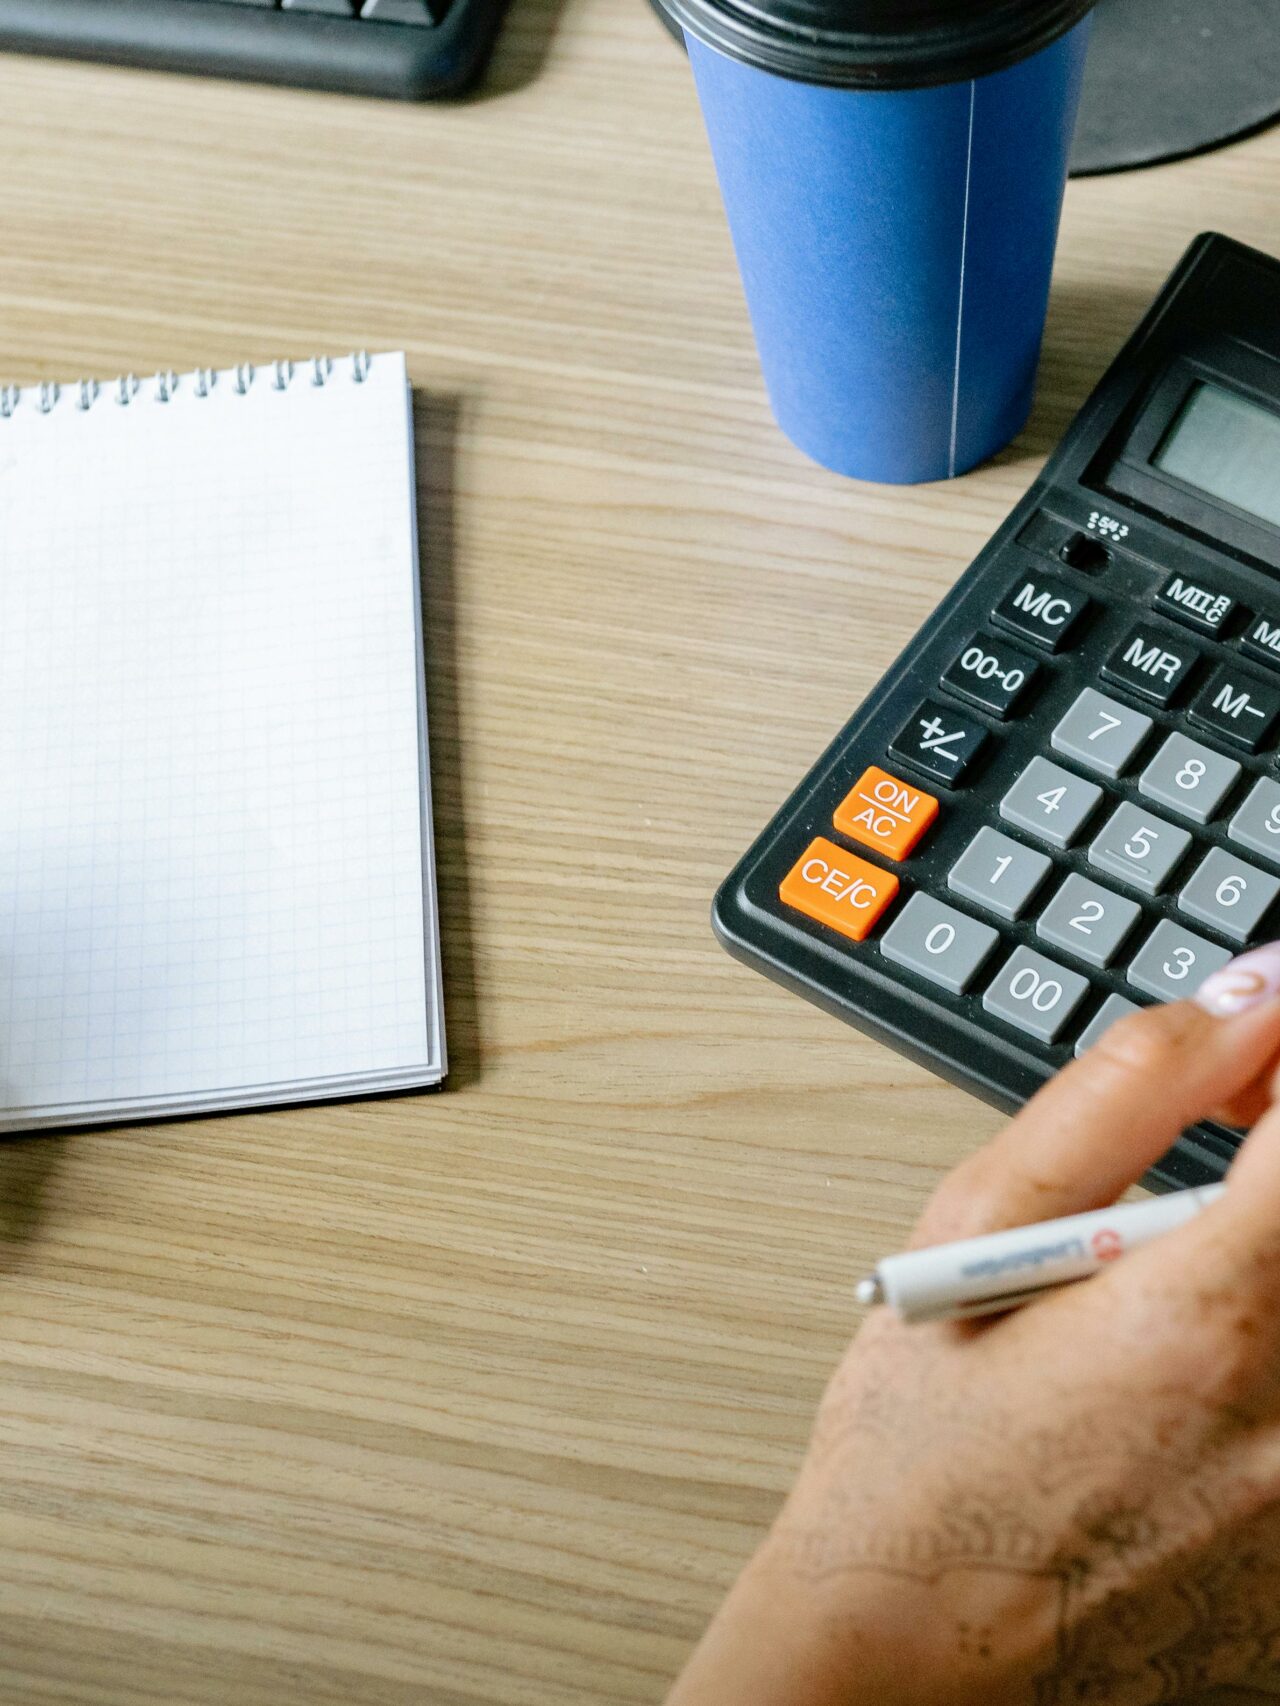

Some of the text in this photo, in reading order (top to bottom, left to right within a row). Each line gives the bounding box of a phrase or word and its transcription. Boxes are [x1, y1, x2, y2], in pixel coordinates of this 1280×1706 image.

[1013, 584, 1071, 625] MC
[1123, 638, 1181, 684] MR
[1088, 712, 1122, 741] 7
[1175, 759, 1207, 790] 8
[874, 780, 920, 814] ON
[1036, 786, 1068, 815] 4
[852, 807, 897, 837] AC
[1124, 826, 1158, 859] 5
[801, 858, 877, 909] CE/C
[995, 855, 1013, 884] 1
[1215, 875, 1247, 907] 6
[1069, 900, 1105, 935] 2
[925, 923, 956, 954] 0
[1162, 947, 1196, 980] 3
[1009, 968, 1062, 1012] 00
